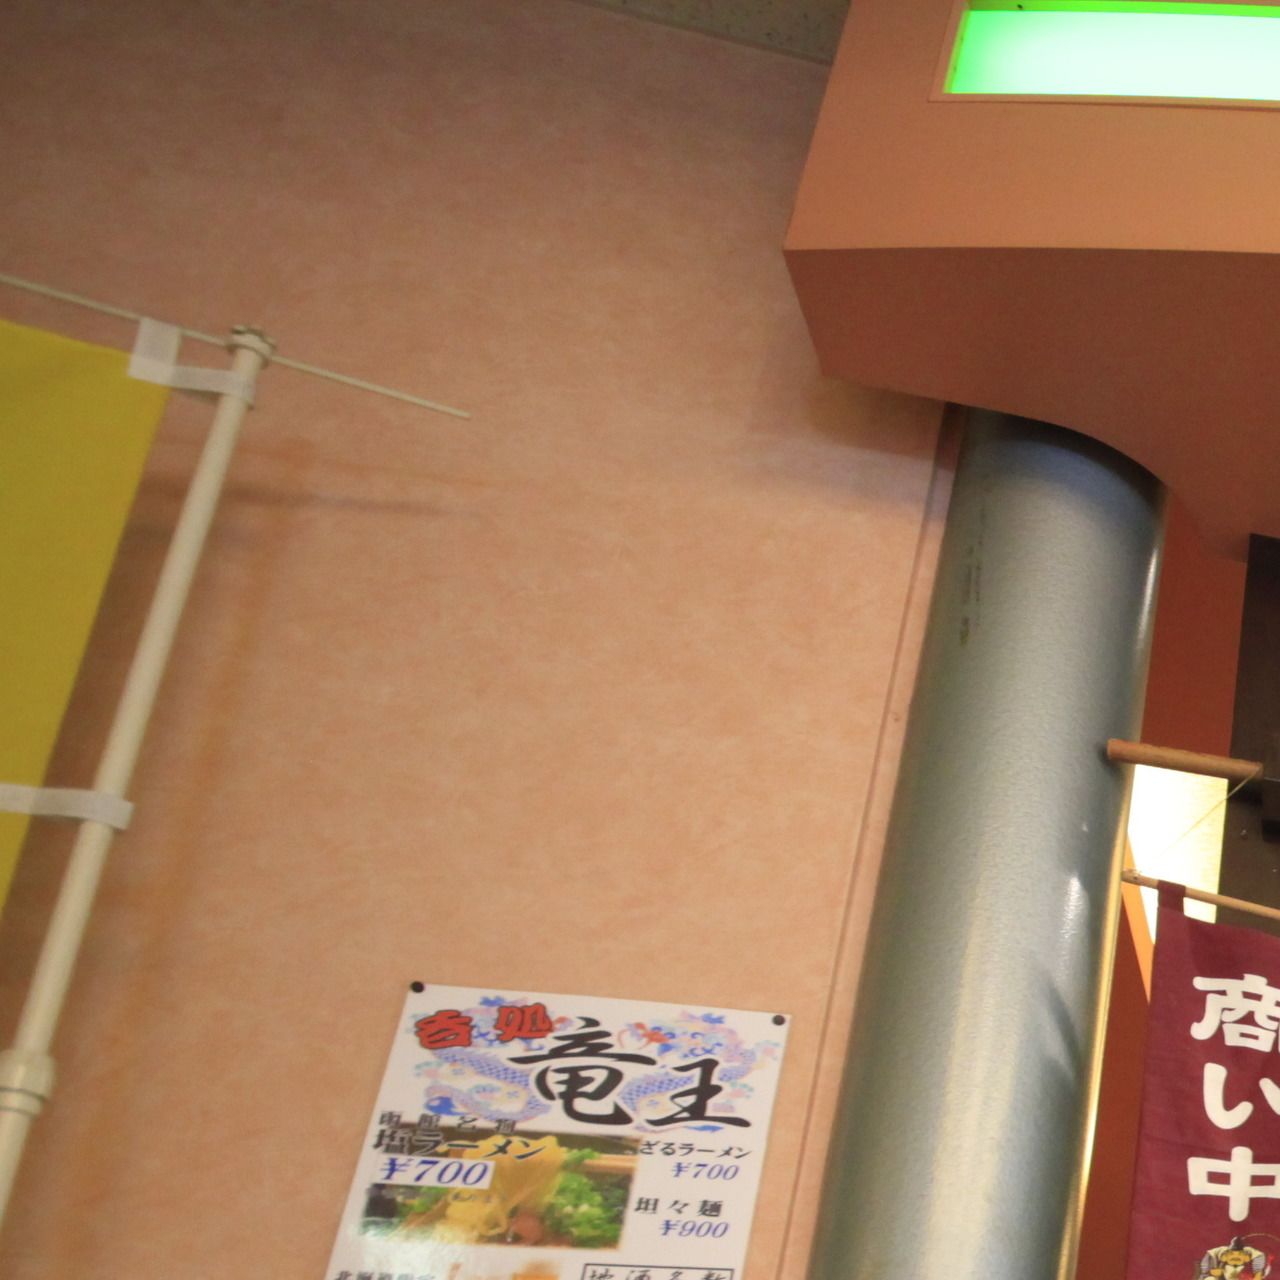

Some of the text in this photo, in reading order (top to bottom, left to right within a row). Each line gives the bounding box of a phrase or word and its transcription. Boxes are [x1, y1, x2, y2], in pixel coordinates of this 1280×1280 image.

[508, 1016, 752, 1129] 竜王
[372, 1128, 546, 1161] 塩ラーメン
[639, 1140, 752, 1160] ざるラーメン
[379, 1157, 489, 1187] ¥700
[672, 1162, 740, 1181] ¥700
[660, 1220, 730, 1239] ¥900
